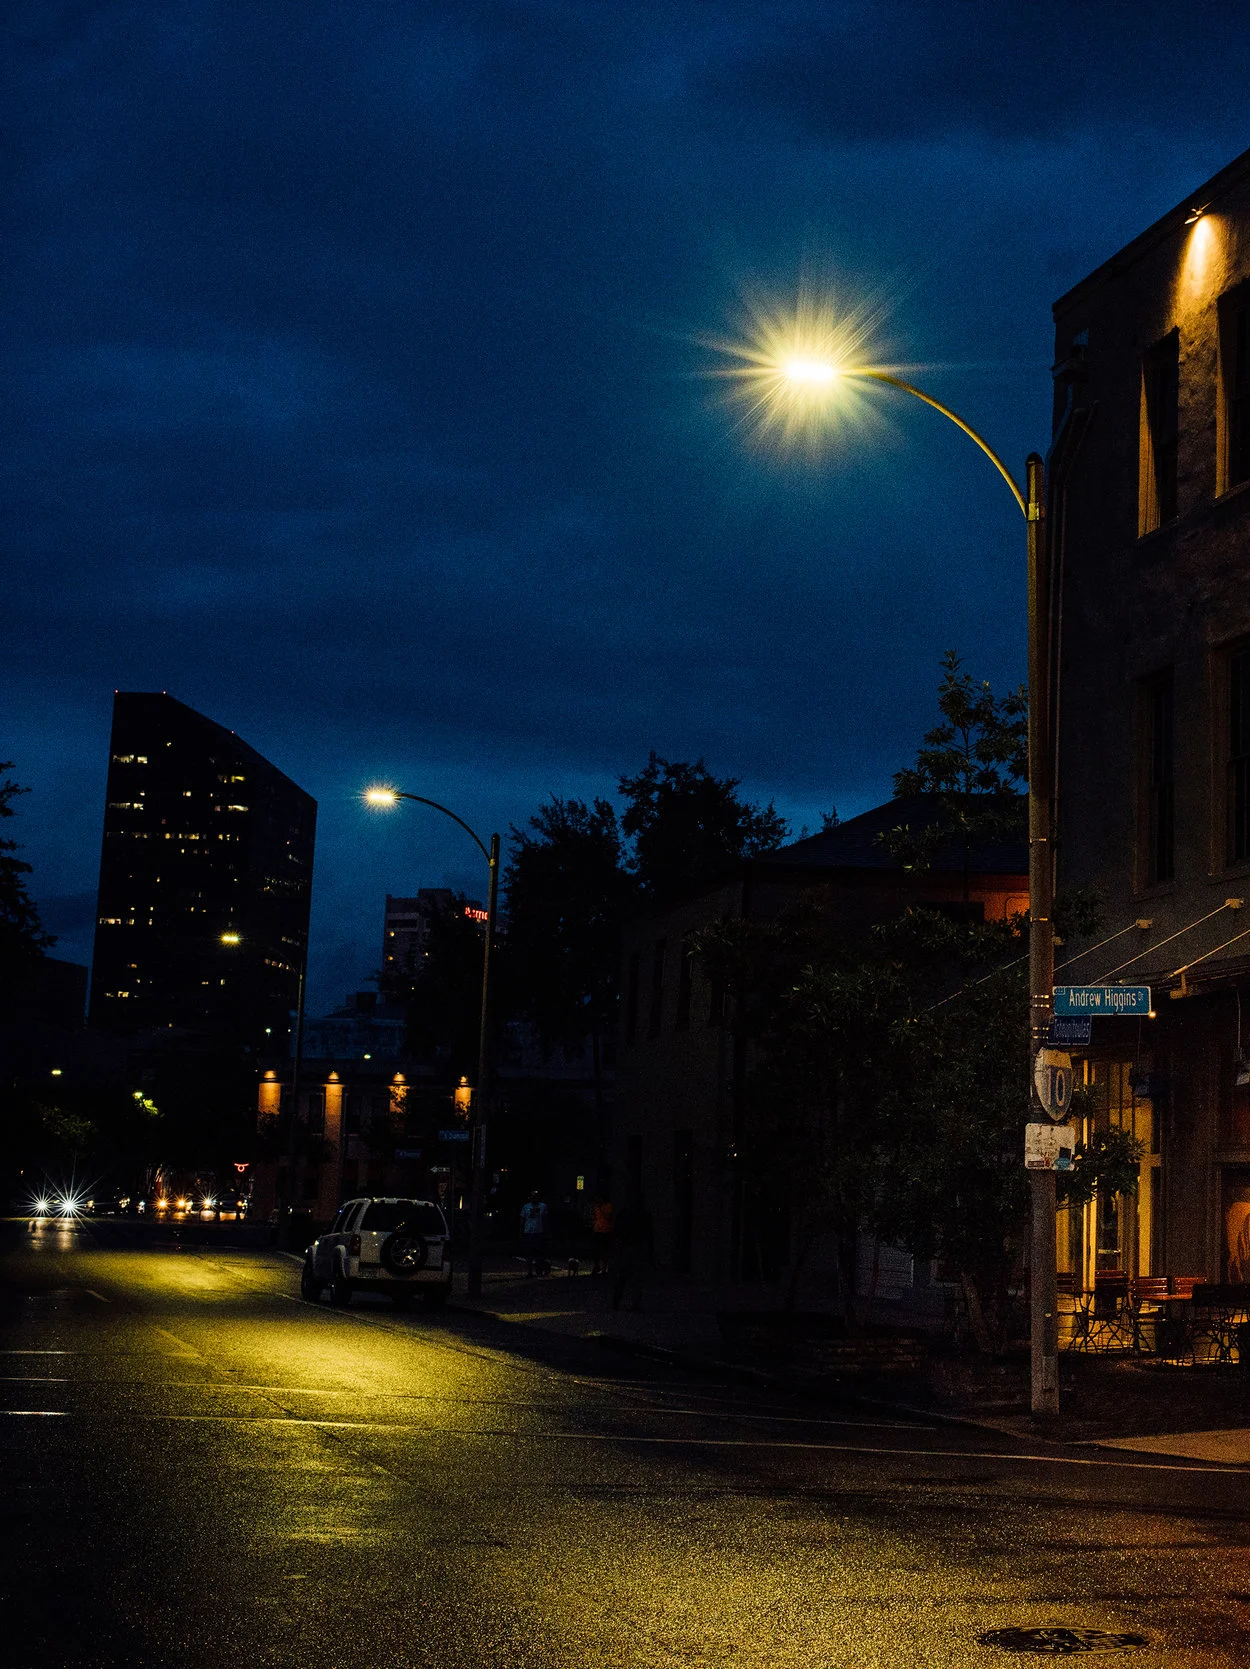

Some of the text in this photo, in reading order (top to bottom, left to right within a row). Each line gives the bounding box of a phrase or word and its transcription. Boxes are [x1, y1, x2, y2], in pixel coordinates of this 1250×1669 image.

[1069, 988, 1144, 1012] Andrew Higgins Dr
[1046, 1067, 1065, 1107] 10
